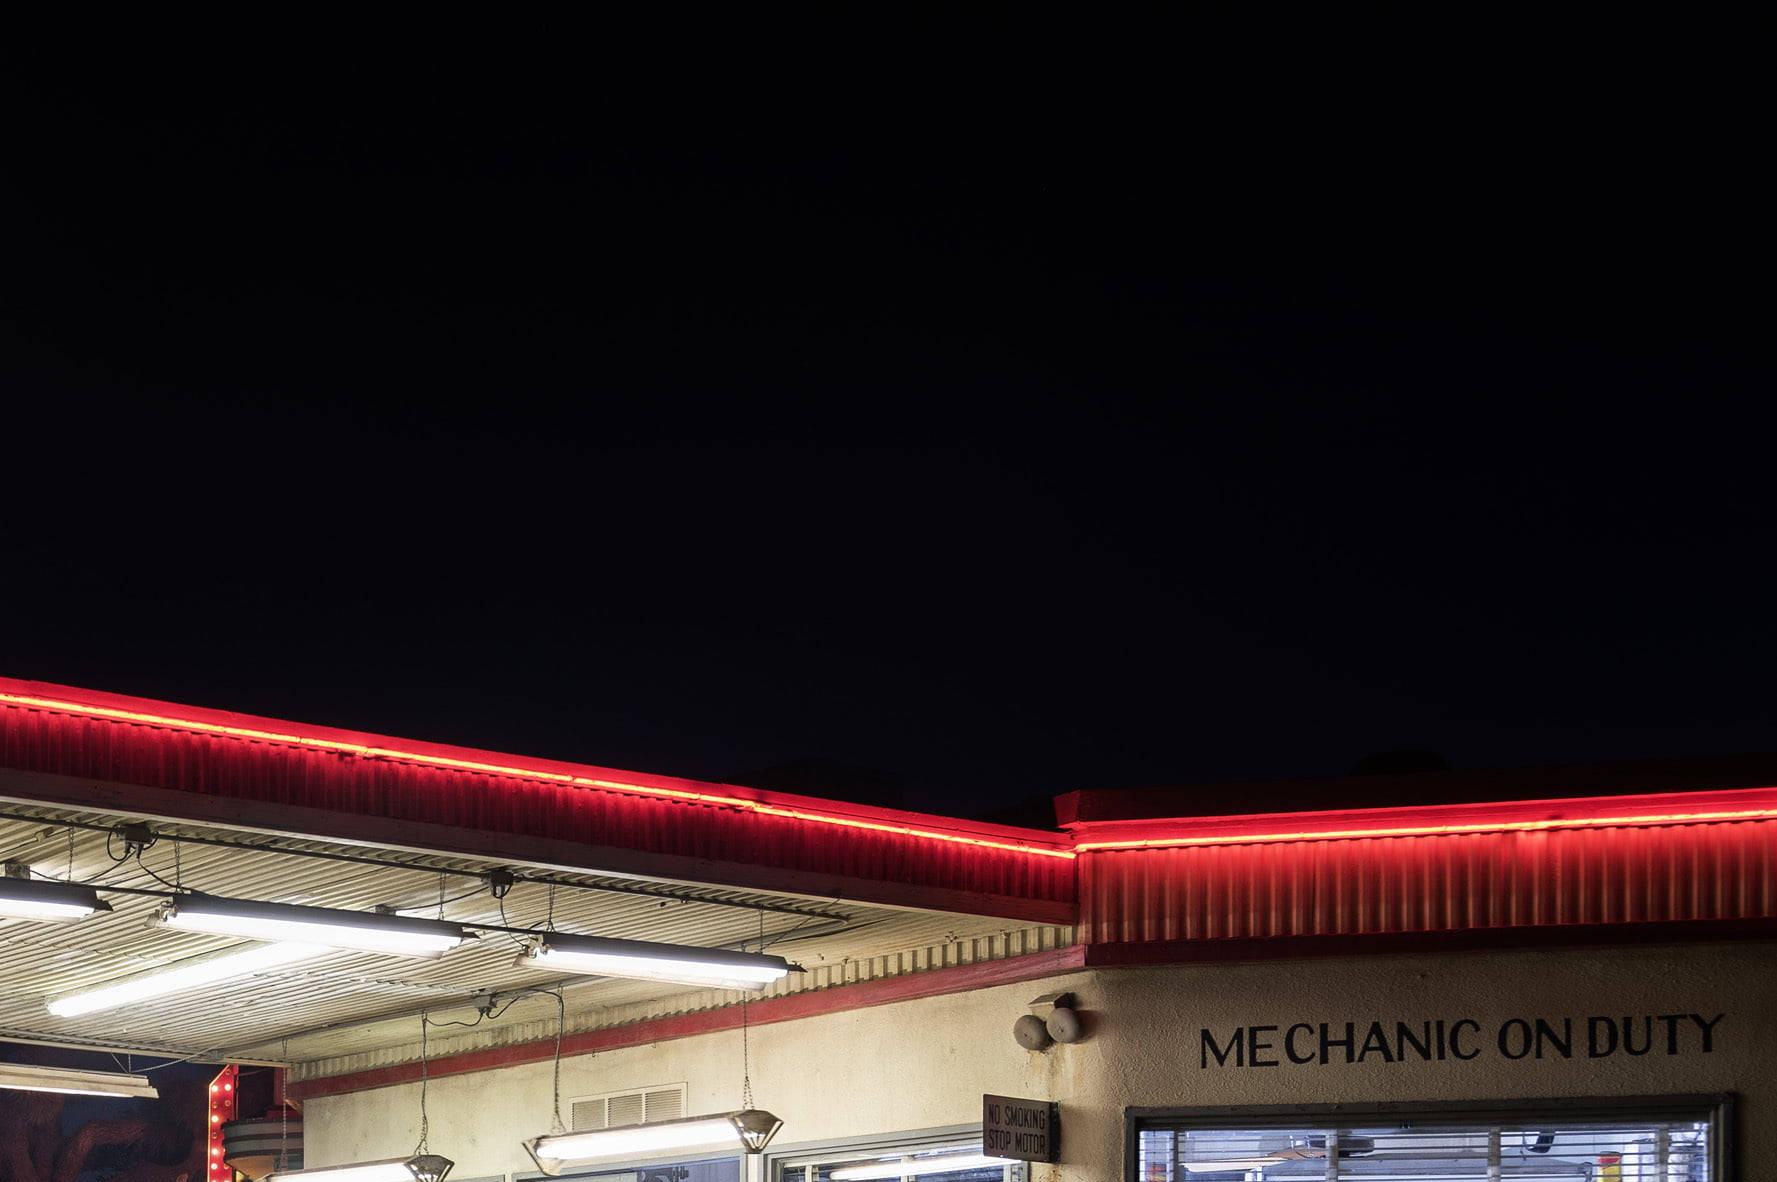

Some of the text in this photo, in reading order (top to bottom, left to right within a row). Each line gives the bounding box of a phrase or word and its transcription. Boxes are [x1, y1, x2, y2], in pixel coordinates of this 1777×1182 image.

[1200, 1013, 1724, 1069] MECHANIC ON DUTY
[988, 1103, 1046, 1130] NO SMOKING
[988, 1129, 1046, 1155] STOP MOTOR
